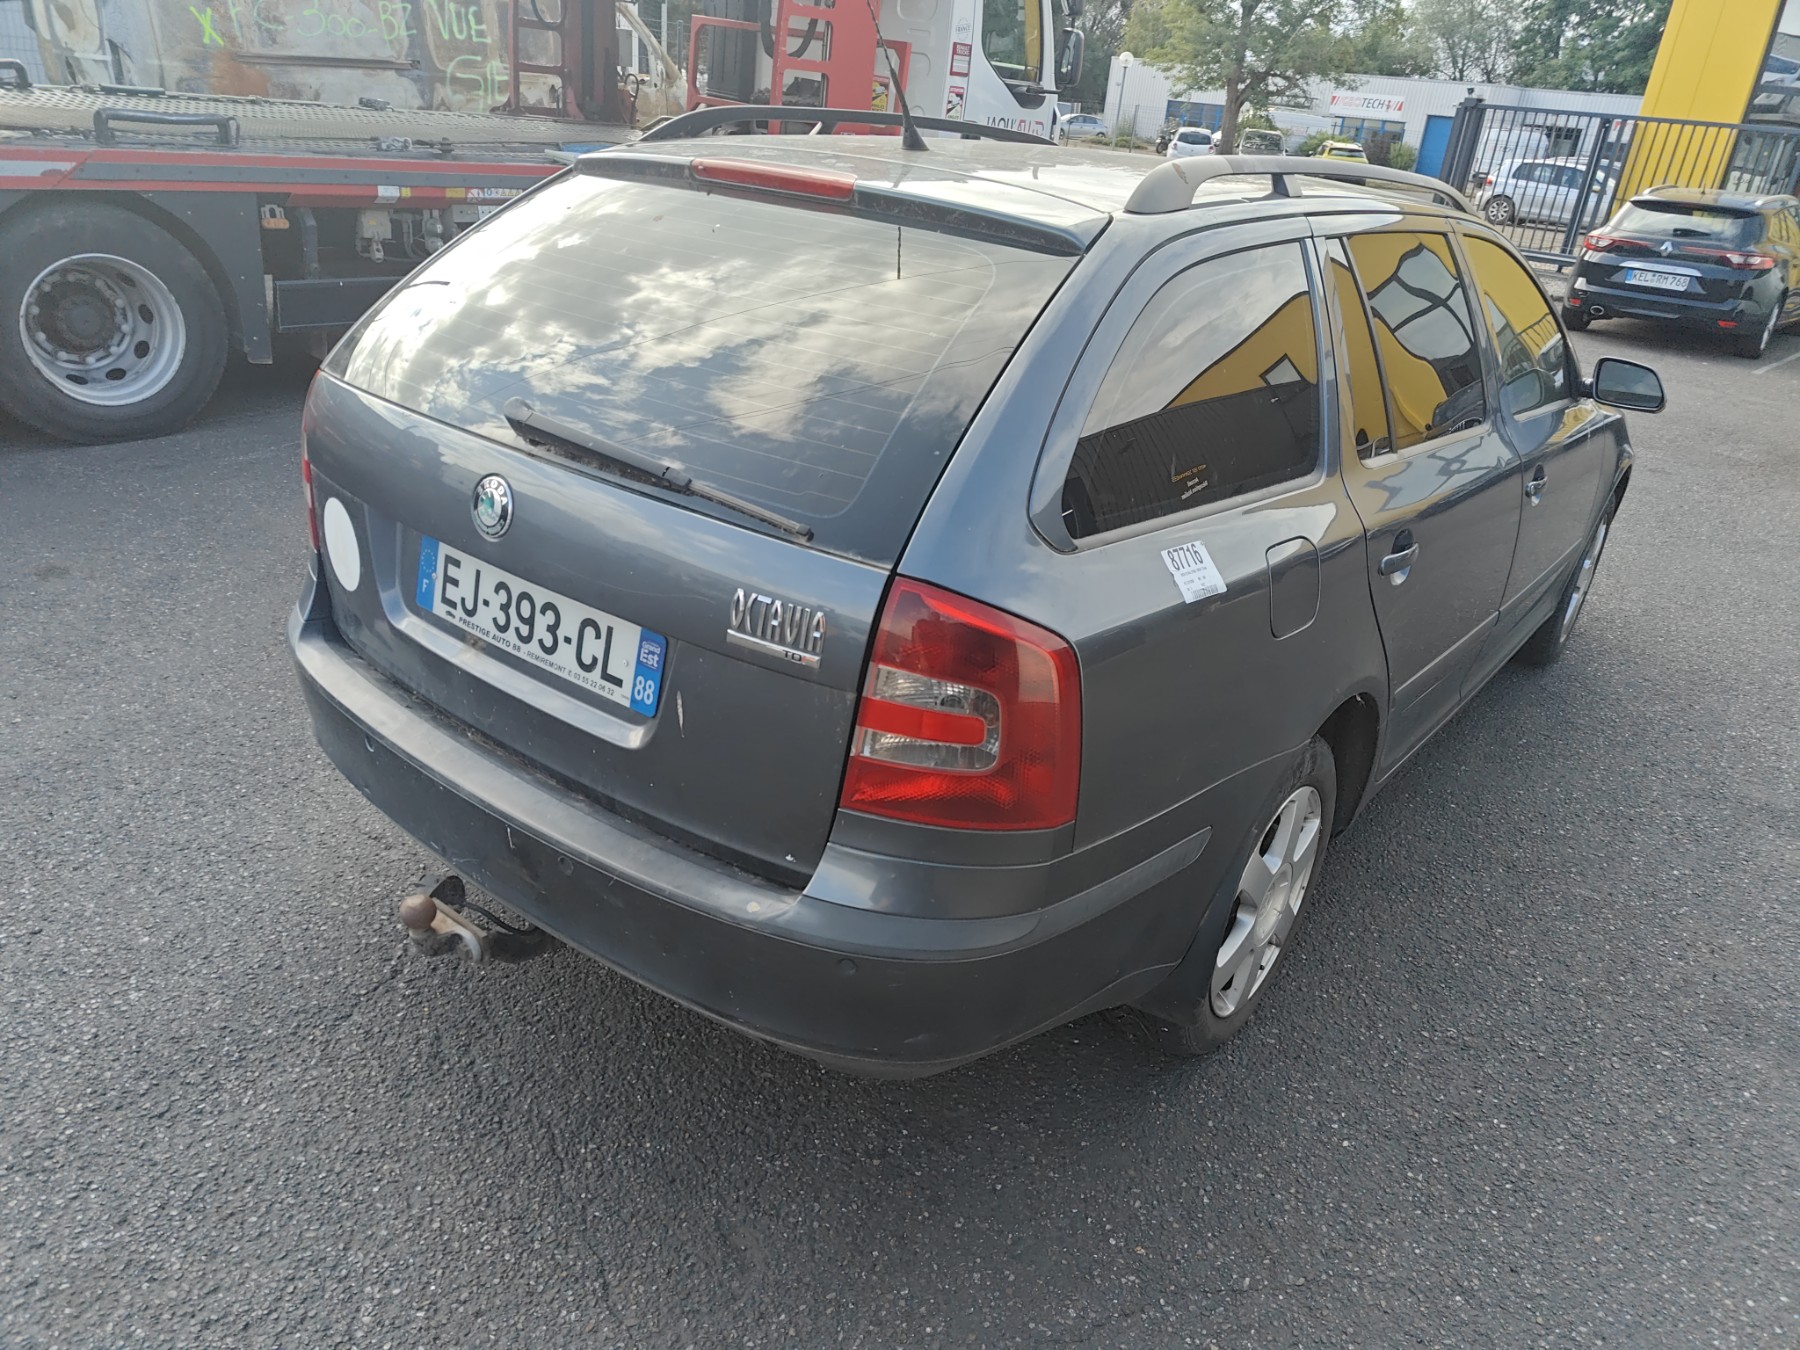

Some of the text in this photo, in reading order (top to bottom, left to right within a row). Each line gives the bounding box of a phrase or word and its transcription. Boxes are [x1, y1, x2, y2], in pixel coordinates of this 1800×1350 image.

[430, 0, 492, 43] VUE
[1632, 271, 1649, 283] KEL
[1669, 276, 1689, 288] 768
[1167, 543, 1203, 571] 87716
[421, 578, 430, 593] F
[440, 553, 624, 689] EJ-393-CL
[458, 616, 491, 638] PRESTIGE
[491, 633, 511, 648] AUTO
[729, 588, 826, 653] OCTAVIA
[639, 648, 659, 667] Est
[634, 675, 655, 705] 88
